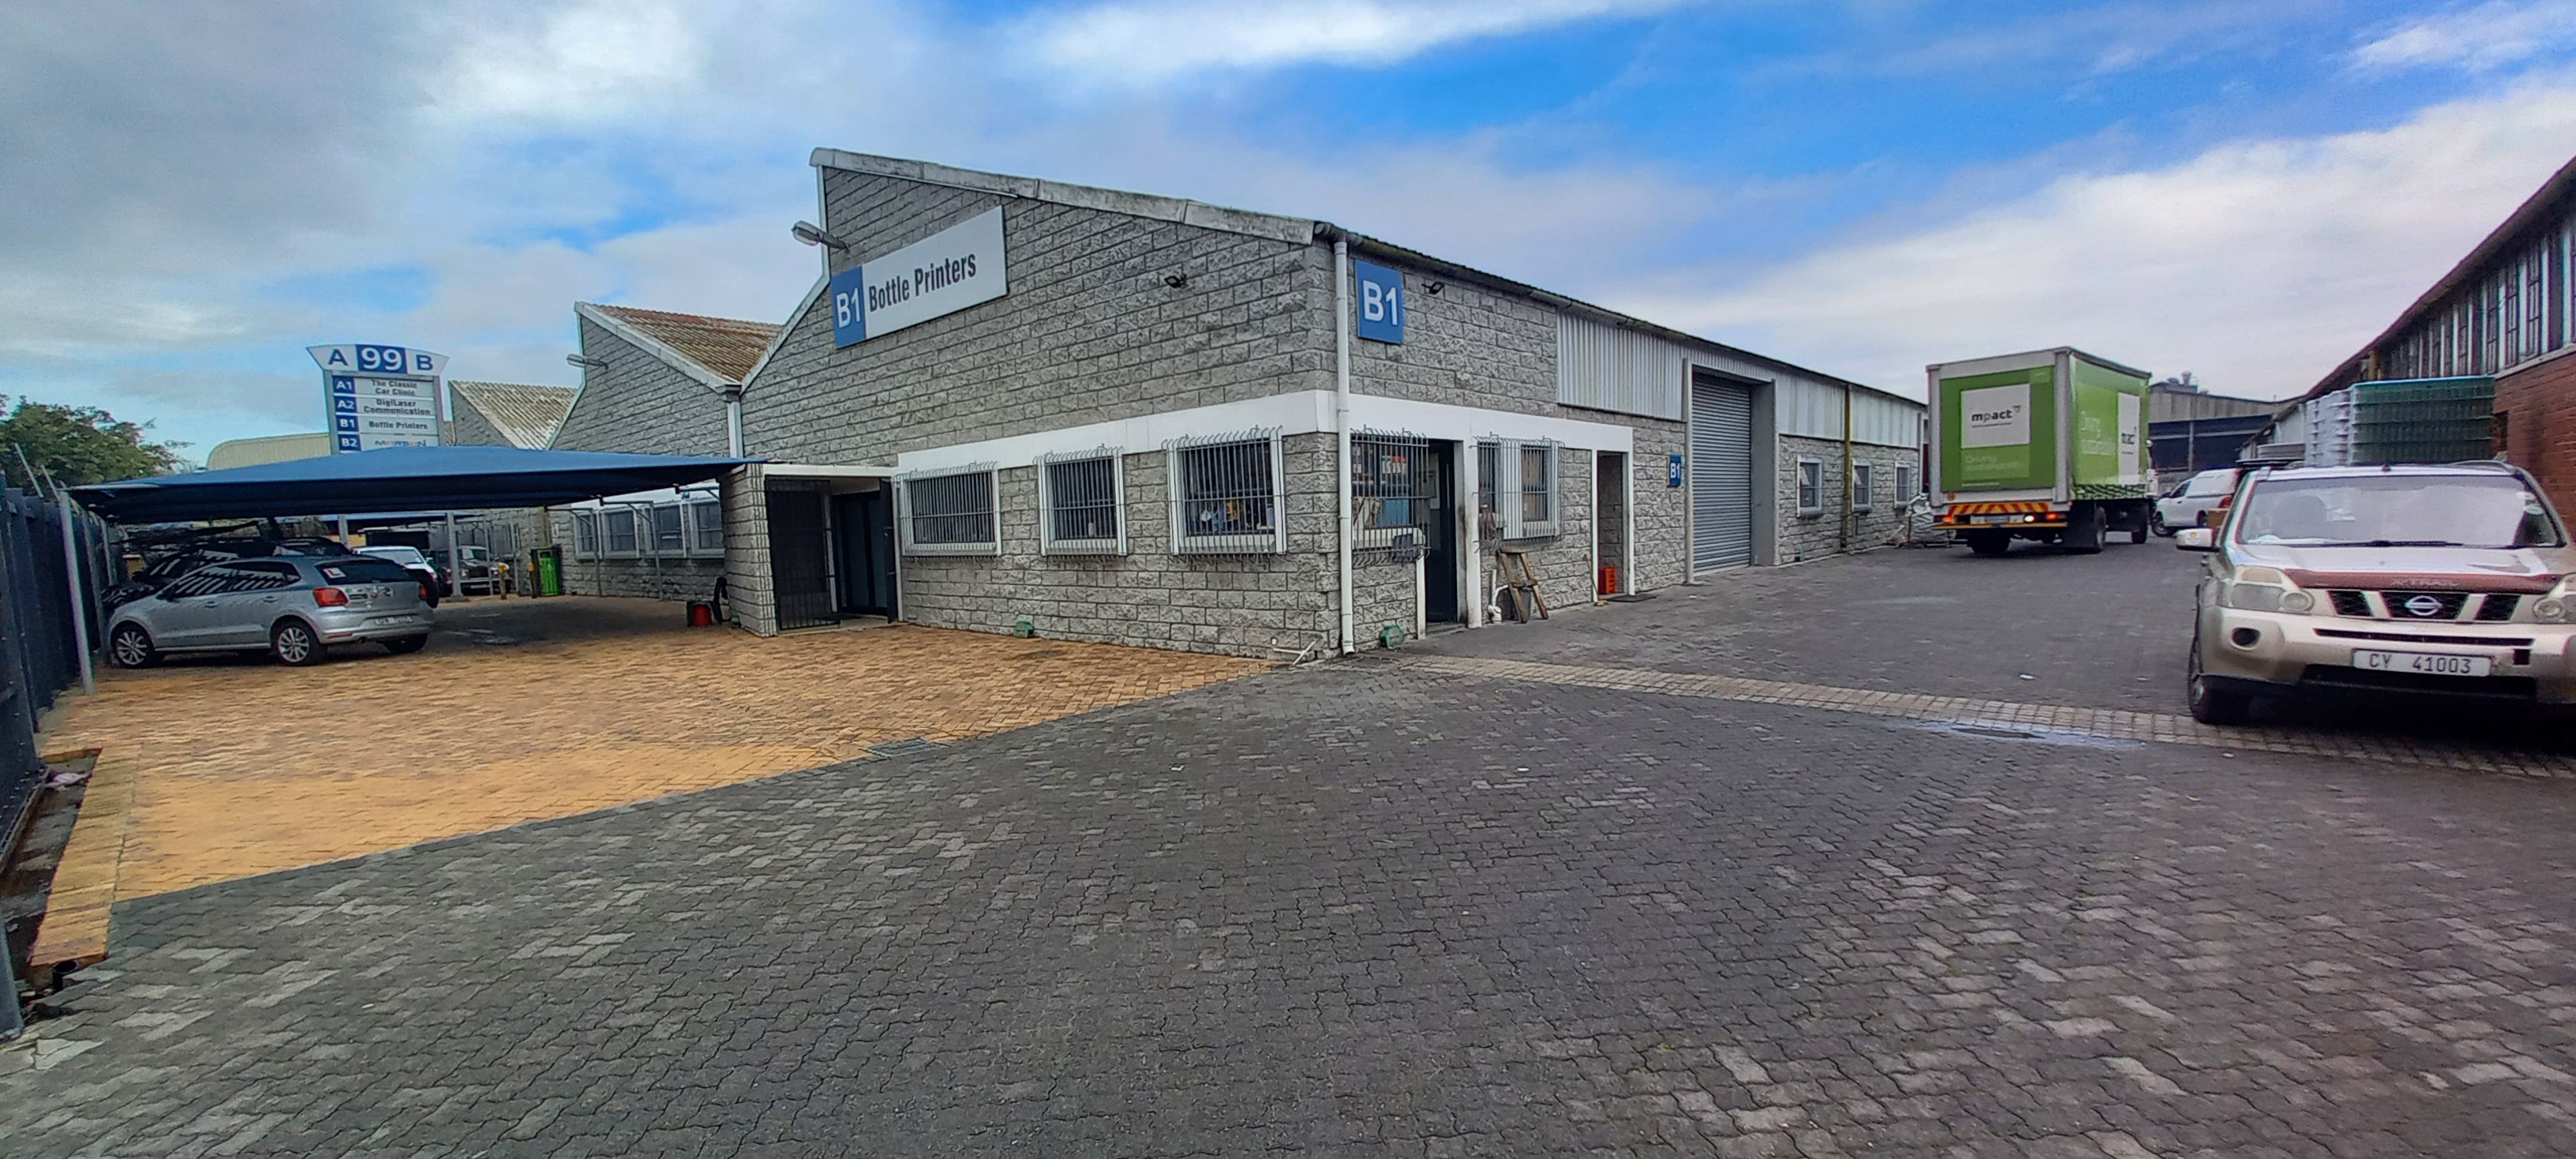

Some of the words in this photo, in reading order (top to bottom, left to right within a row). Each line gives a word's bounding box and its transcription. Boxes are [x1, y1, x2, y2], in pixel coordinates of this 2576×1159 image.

[836, 287, 861, 328] B1
[868, 276, 910, 313] Bottle
[914, 253, 976, 297] Printers
[1363, 279, 1398, 326] B1
[328, 349, 349, 366] A
[361, 347, 403, 371] 99
[416, 354, 433, 370] B
[335, 381, 353, 390] A1
[388, 381, 417, 389] Classic
[337, 400, 355, 410] A2
[364, 406, 430, 415] Communication
[1971, 409, 2012, 423] mpact
[339, 419, 355, 428] B1
[395, 422, 429, 430] Printers
[341, 438, 358, 448] B2
[1670, 463, 1680, 479] B1
[2369, 653, 2392, 669] CY
[2412, 656, 2472, 674] 41003
